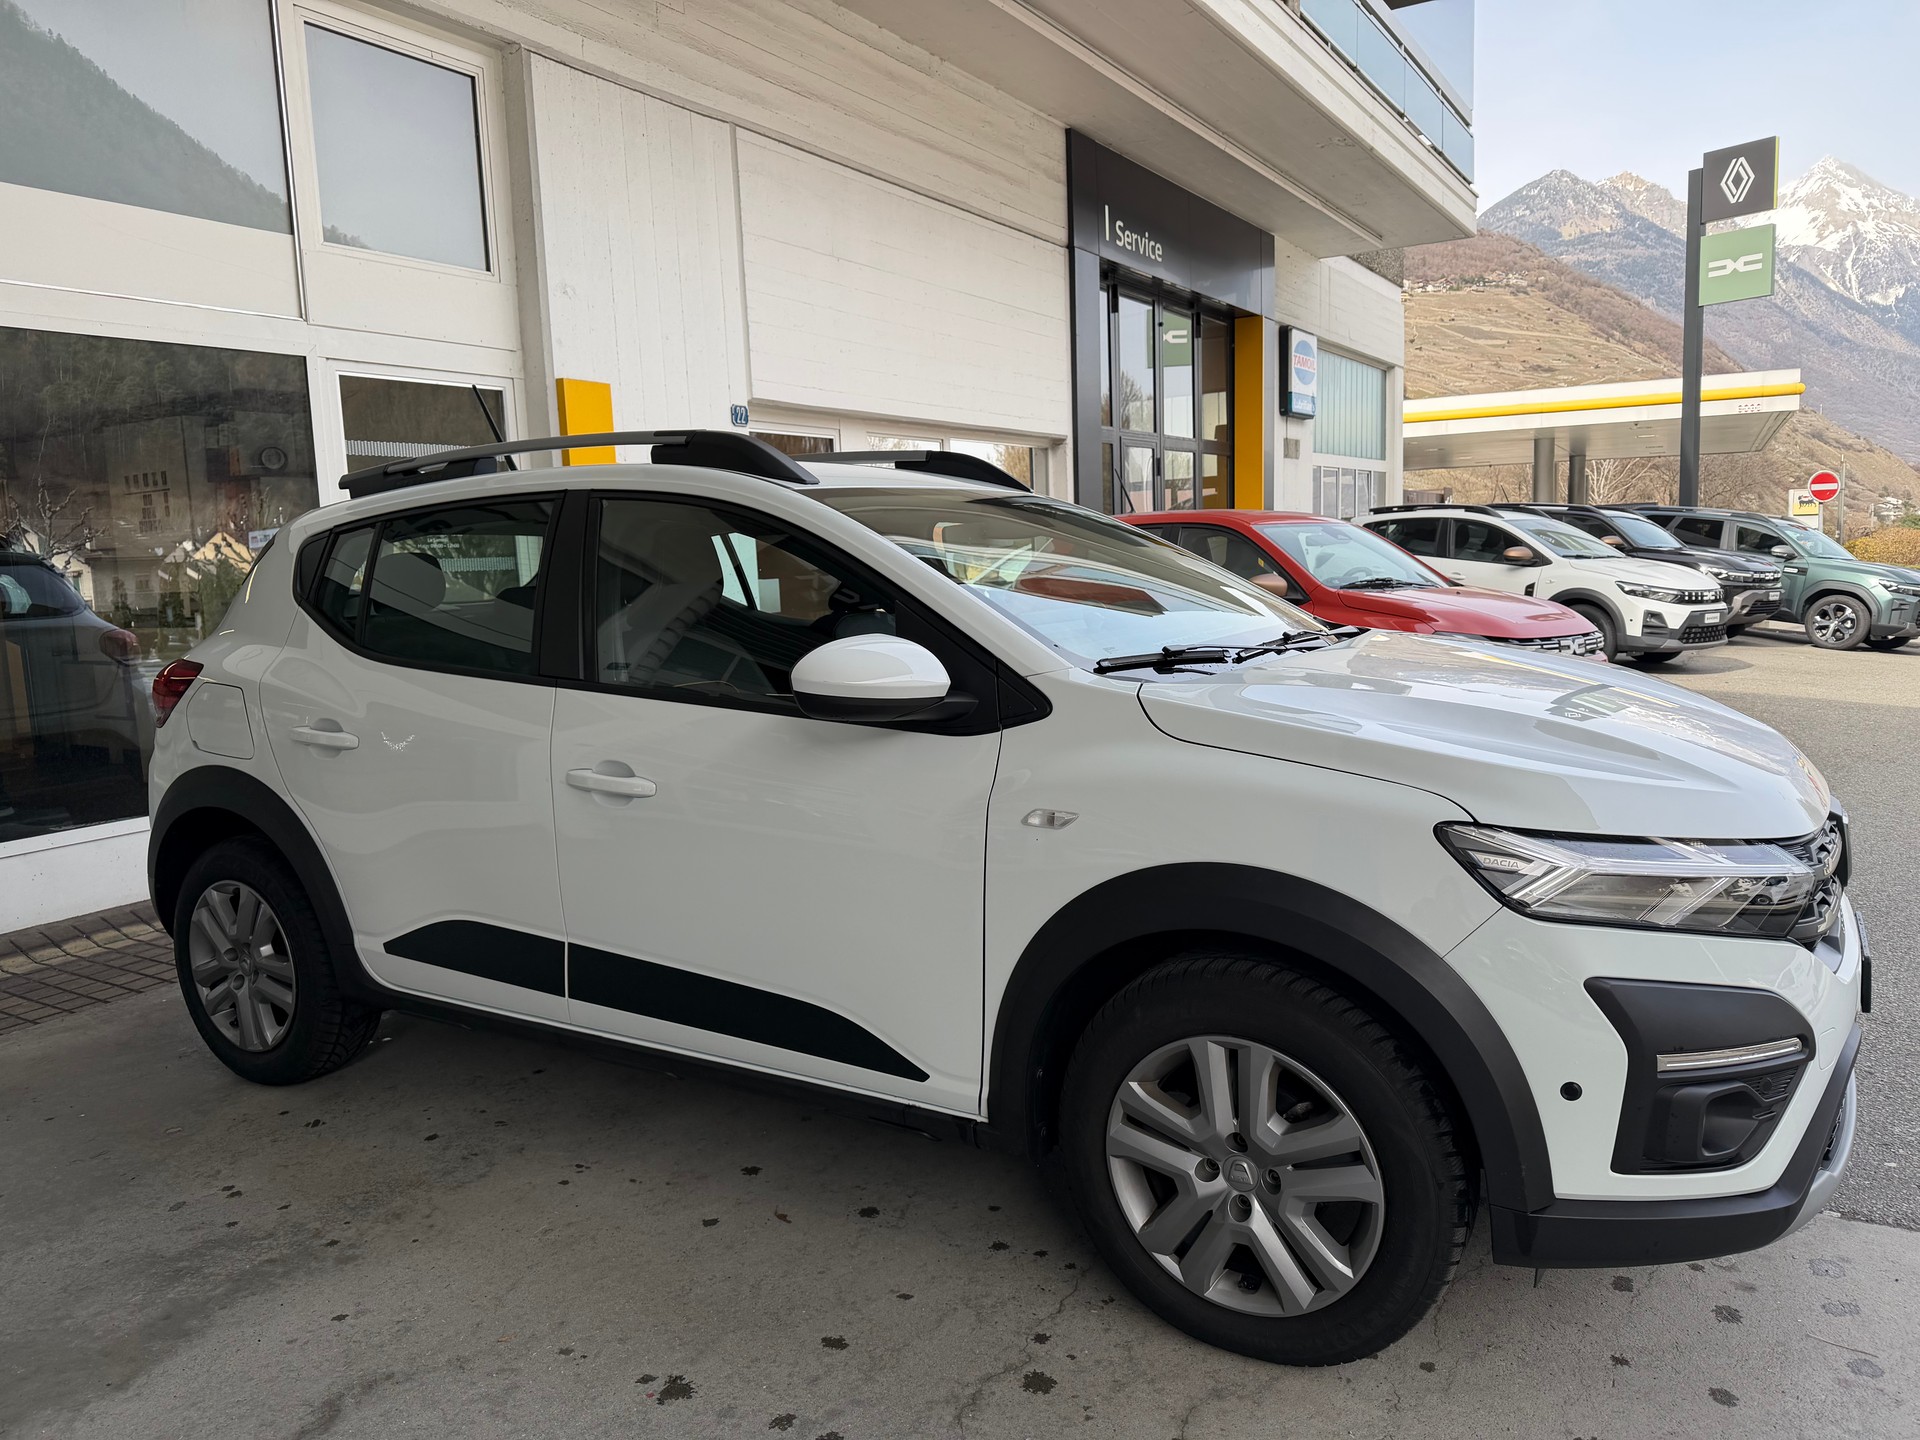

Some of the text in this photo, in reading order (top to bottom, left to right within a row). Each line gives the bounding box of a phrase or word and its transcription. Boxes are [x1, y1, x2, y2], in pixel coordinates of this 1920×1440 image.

[1115, 220, 1163, 262] Service
[1293, 354, 1316, 371] TAMOIL
[736, 406, 746, 423] 22
[1483, 857, 1519, 869] DACIA
